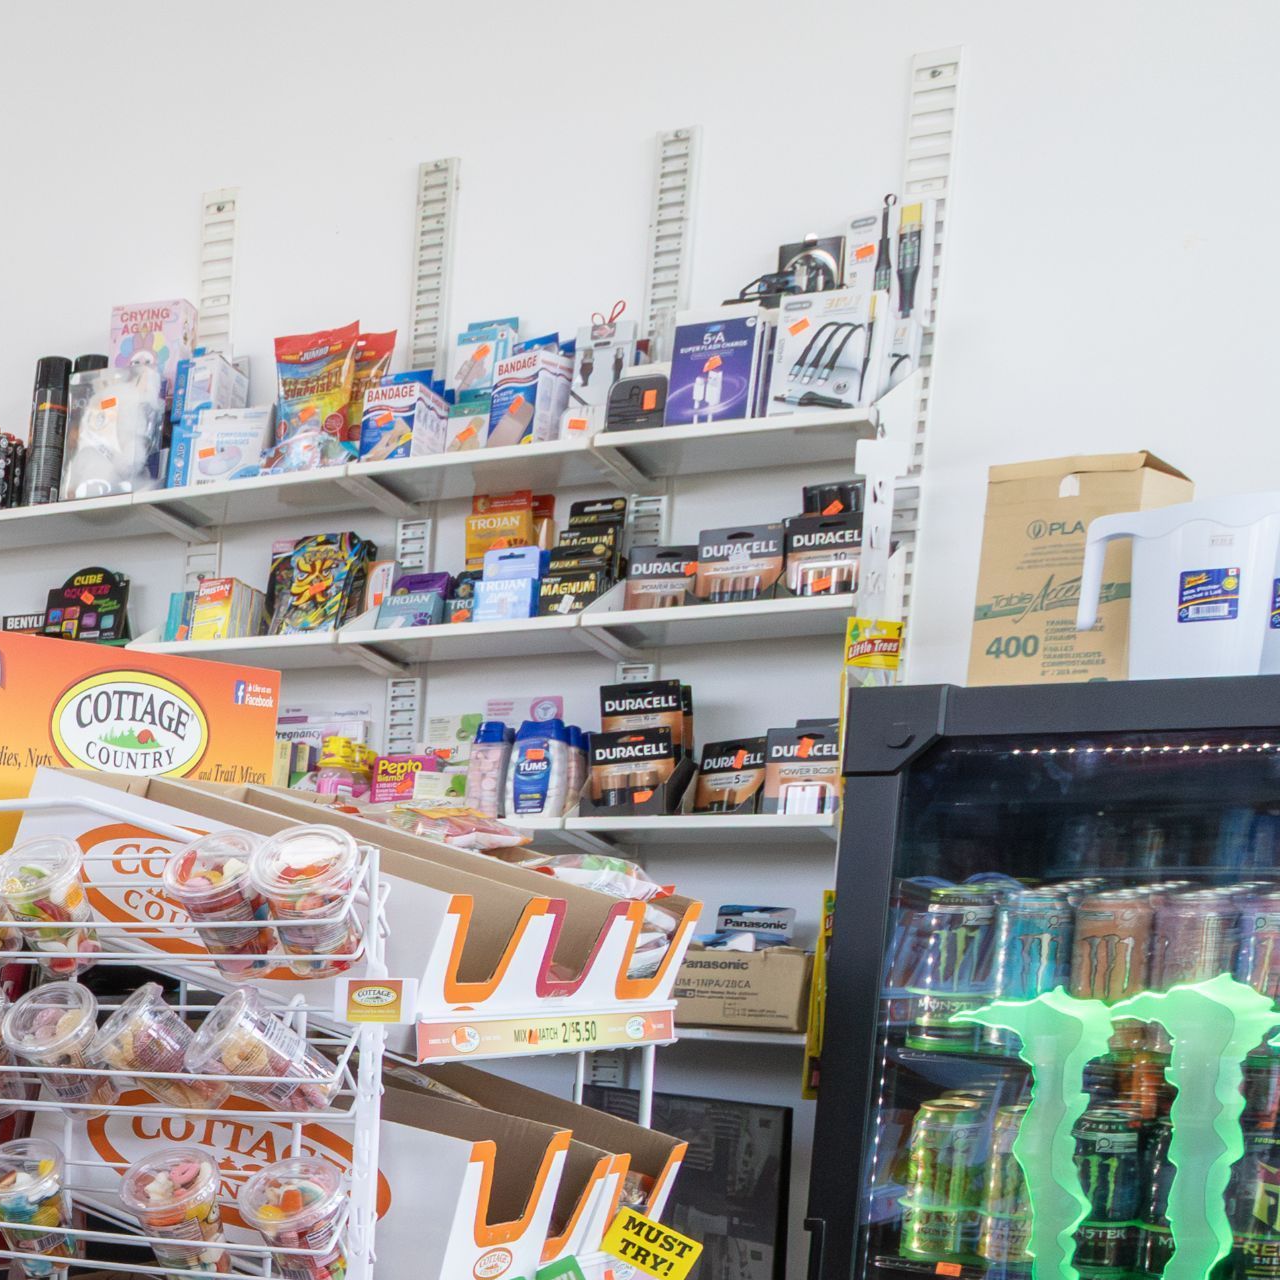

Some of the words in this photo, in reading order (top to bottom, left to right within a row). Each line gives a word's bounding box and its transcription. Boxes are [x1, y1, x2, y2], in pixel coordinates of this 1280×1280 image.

[119, 307, 170, 322] CRYING
[121, 319, 163, 334] AGAIN
[498, 355, 537, 375] BANDAGE
[367, 385, 415, 402] BANDAGE
[469, 516, 520, 530] TROJAN
[702, 541, 777, 558] DURACELL
[74, 574, 104, 586] CUBE
[541, 580, 595, 595] MAGNUM
[386, 594, 430, 606] TROJAN
[874, 640, 898, 653] Trees
[985, 634, 1038, 659] 400
[245, 696, 273, 708] Facebook
[605, 696, 676, 712] DURACELL
[76, 690, 190, 741] COTTAGE
[86, 741, 175, 769] COUNTRY
[595, 744, 667, 760] DURACELL
[214, 764, 237, 782] Trail
[239, 766, 266, 784] Mixes
[378, 759, 422, 777] Pepto
[519, 761, 547, 772] TUMS
[723, 919, 788, 931] Panasonic
[681, 958, 749, 971] Panasonic
[356, 989, 392, 1000] COTTAGE
[513, 1029, 527, 1043] MIX
[562, 1020, 597, 1044] 2/$5.50
[621, 1216, 692, 1259] MUST
[620, 1239, 675, 1278] TRY!
